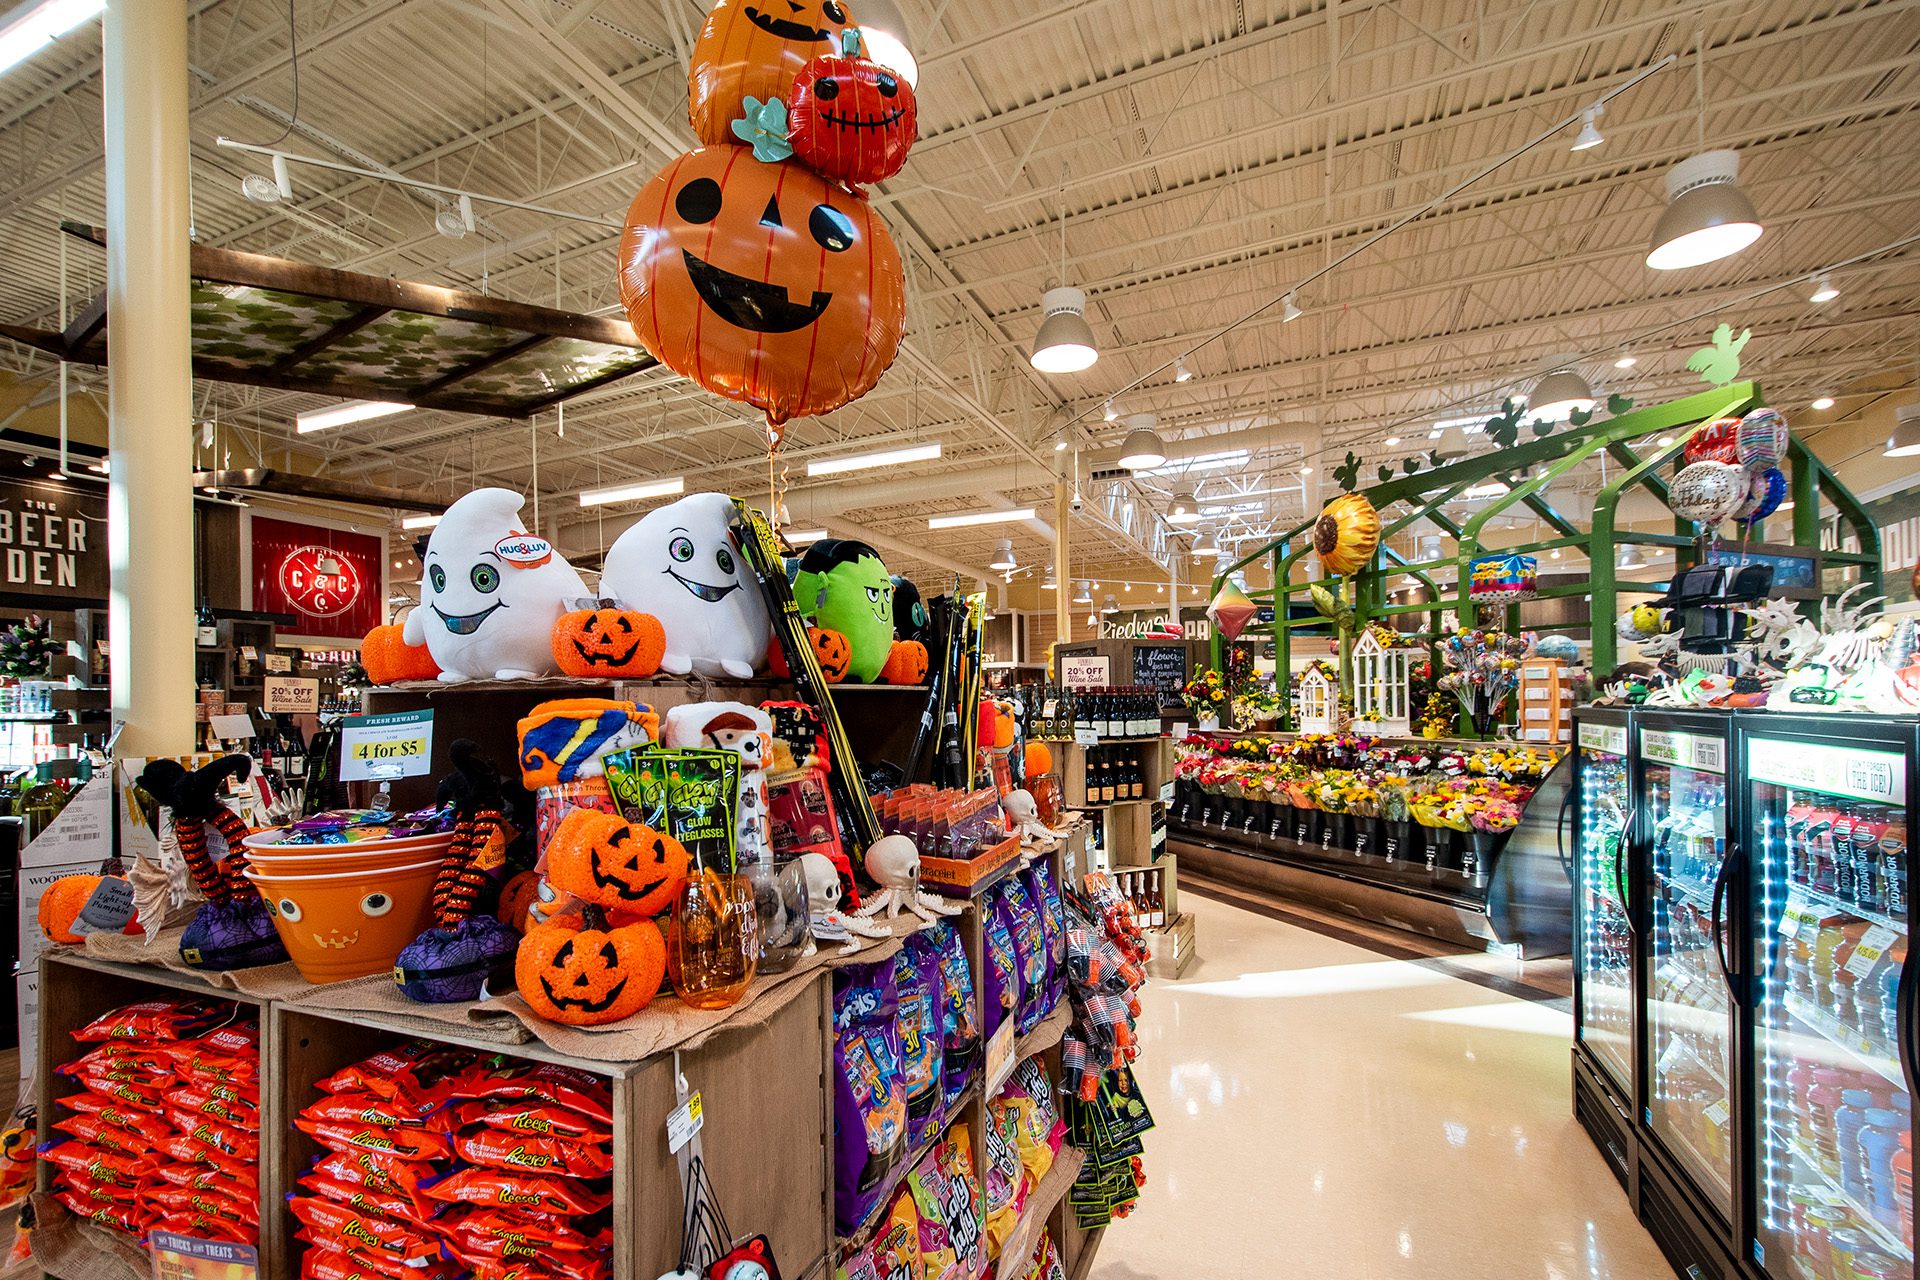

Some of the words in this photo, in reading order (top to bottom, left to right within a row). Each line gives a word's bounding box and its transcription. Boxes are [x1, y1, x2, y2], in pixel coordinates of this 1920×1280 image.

[25, 499, 57, 511] THE
[0, 509, 87, 552] BEER
[7, 548, 77, 587] DEN
[1147, 650, 1181, 666] flower
[1086, 667, 1103, 675] OFF
[392, 715, 419, 723] REWARD
[359, 744, 368, 759] 4
[374, 744, 397, 758] for
[400, 740, 418, 756] $5
[1852, 770, 1868, 789] THE
[687, 816, 711, 826] GLOW
[675, 829, 725, 842] EYEGLASSES
[110, 887, 133, 897] Small
[1891, 855, 1905, 910] BODYARMOR
[92, 901, 129, 915] Pumpkin
[905, 1029, 920, 1053] 30
[360, 1107, 398, 1127] Reese's
[512, 1111, 552, 1134] Reese's
[923, 1120, 939, 1138] 30
[350, 1130, 393, 1150] Reese's
[504, 1146, 550, 1168] Reese's
[499, 1186, 541, 1206] Reese's
[343, 1219, 380, 1247] Reese's
[167, 1236, 191, 1252] TRICKS
[205, 1244, 233, 1259] TREATS
